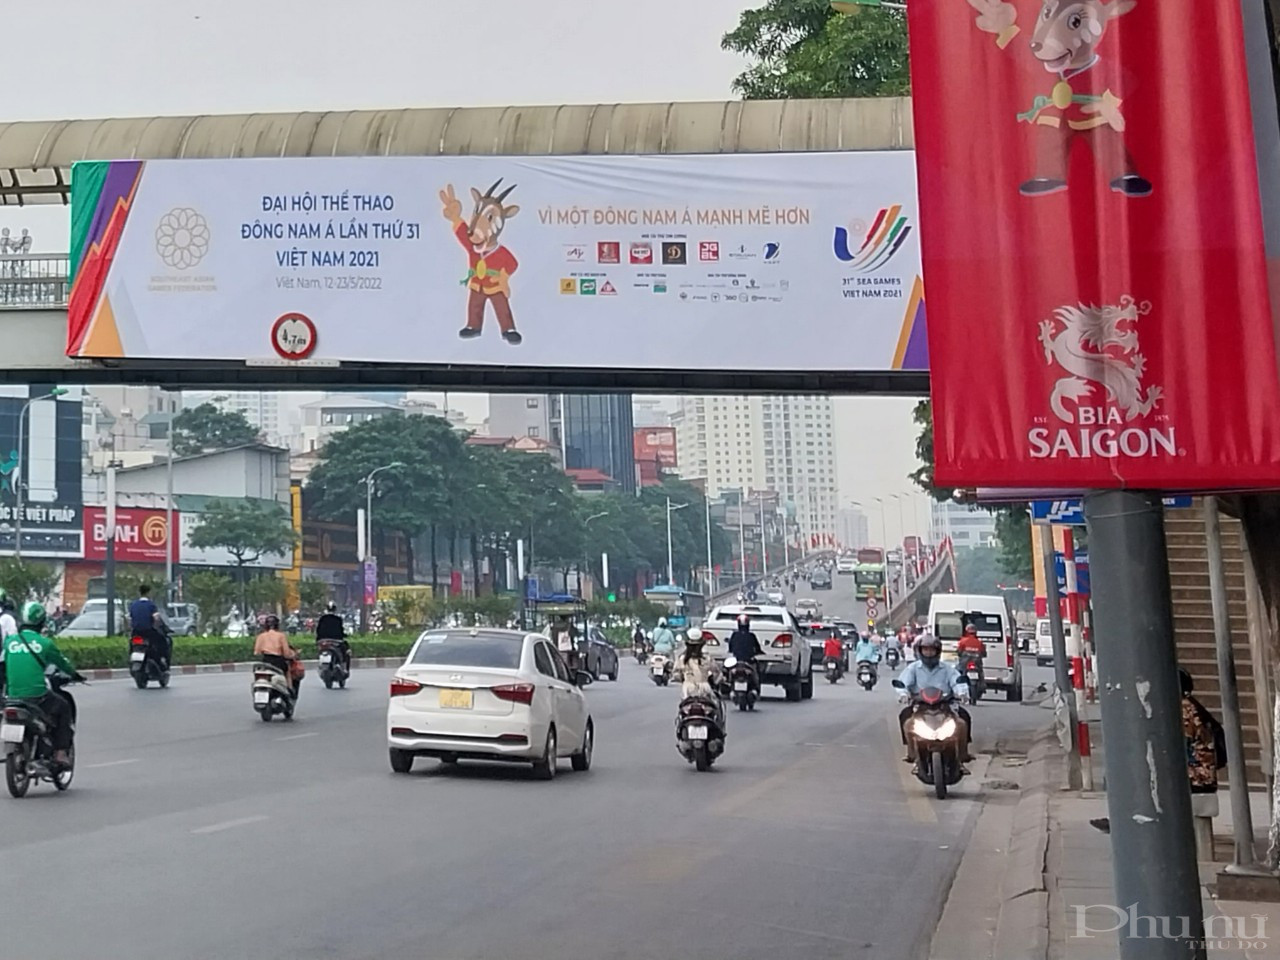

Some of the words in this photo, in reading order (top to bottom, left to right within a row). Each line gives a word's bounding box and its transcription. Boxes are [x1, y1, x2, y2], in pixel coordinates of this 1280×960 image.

[262, 195, 288, 214] ĐẠI
[292, 193, 317, 214] HỘI
[321, 189, 349, 211] THỂ
[352, 195, 394, 211] THAO
[241, 218, 283, 240] ĐÔNG
[288, 223, 320, 239] NAM
[325, 219, 336, 239] Á
[339, 215, 368, 239] LẦN
[371, 219, 404, 239] THỨ
[407, 223, 420, 239] 31
[538, 204, 553, 225] VÌ
[557, 206, 590, 229] MỘT
[593, 205, 639, 226] ĐÔNG
[642, 209, 677, 226] NAM
[681, 205, 693, 225] Á
[696, 209, 744, 229] MẠNH
[748, 205, 770, 225] MẼ
[775, 208, 810, 225] HƠN
[276, 247, 307, 270] VIỆT
[312, 251, 345, 267] NAM
[349, 251, 380, 267] 2021
[842, 289, 862, 298] VIET
[863, 289, 881, 298] NAM
[883, 288, 902, 298] 2021
[856, 277, 871, 285] SEA
[873, 277, 902, 286] GAMES
[1078, 406, 1123, 425] BIA
[1028, 427, 1177, 458] SAIGON
